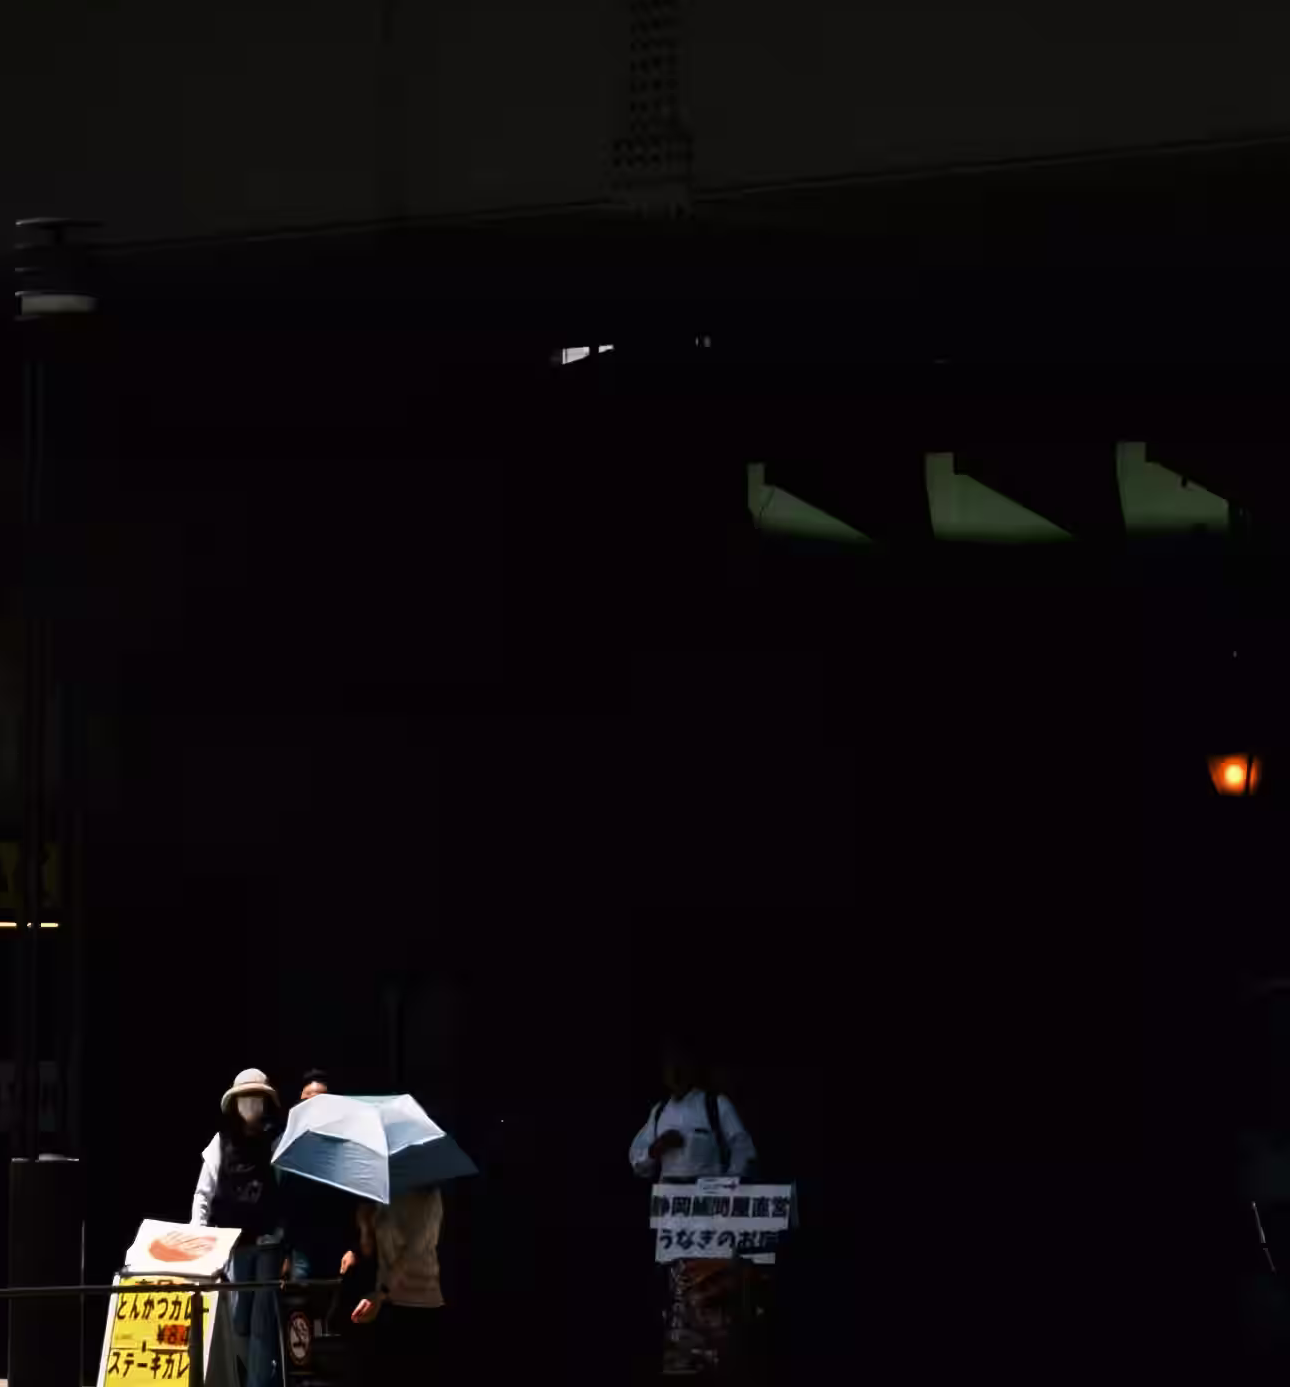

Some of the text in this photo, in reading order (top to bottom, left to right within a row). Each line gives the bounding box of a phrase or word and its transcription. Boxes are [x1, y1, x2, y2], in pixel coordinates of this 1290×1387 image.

[107, 1350, 191, 1380] ステーキカレ
